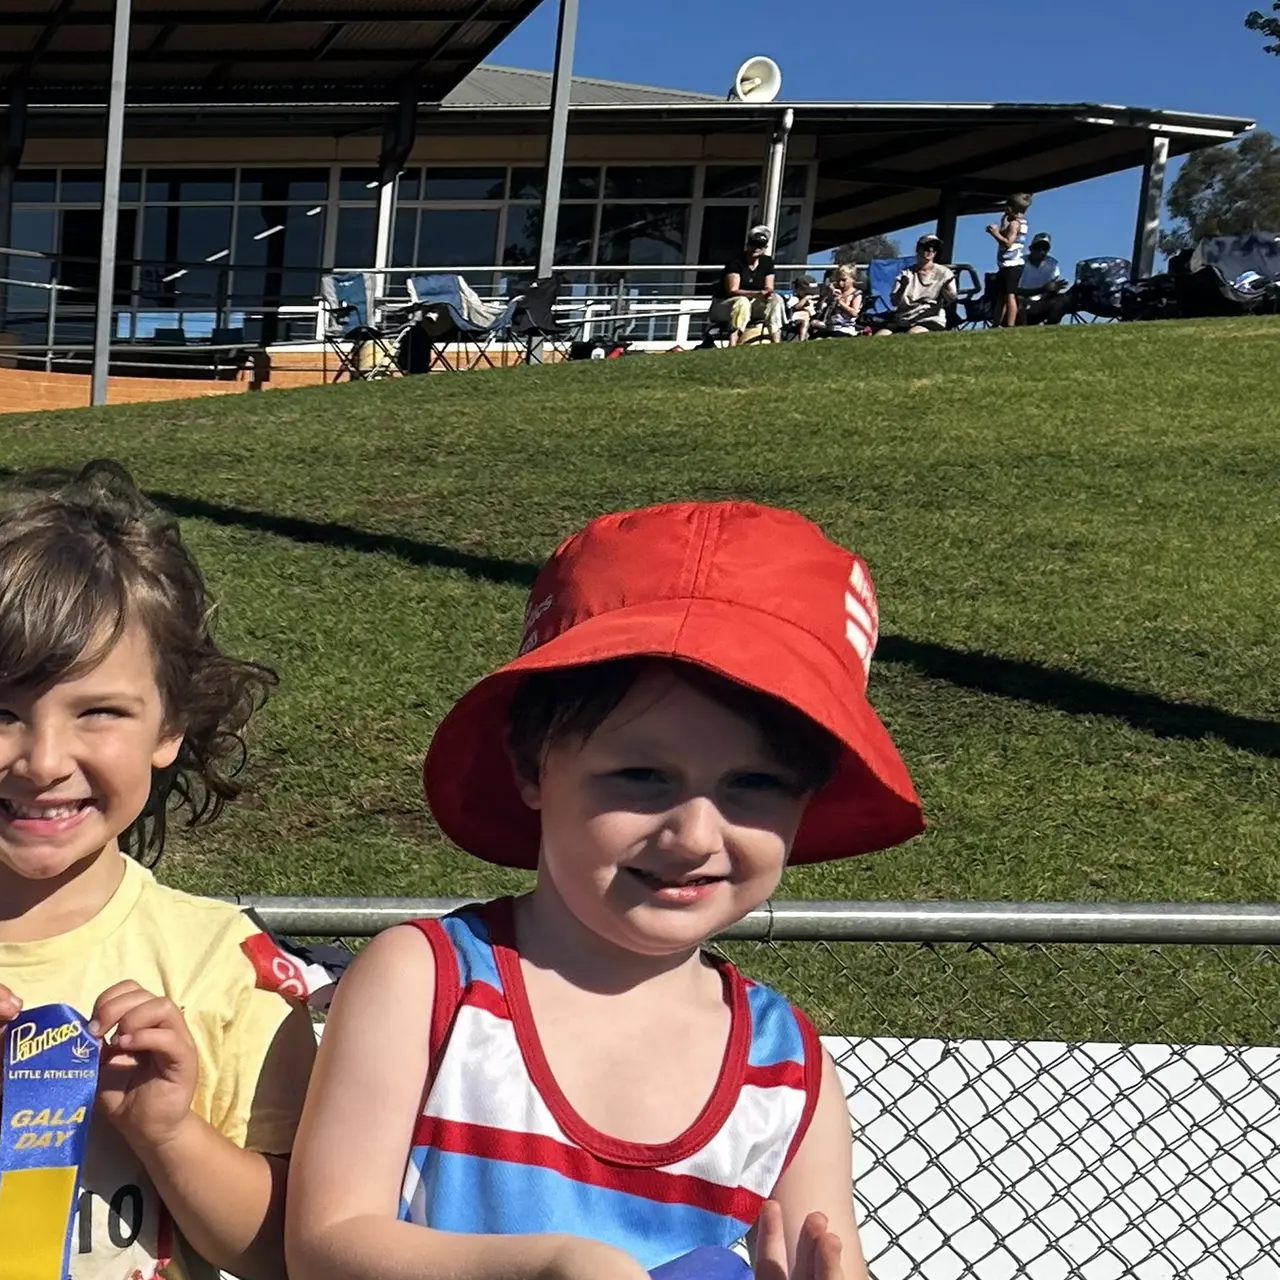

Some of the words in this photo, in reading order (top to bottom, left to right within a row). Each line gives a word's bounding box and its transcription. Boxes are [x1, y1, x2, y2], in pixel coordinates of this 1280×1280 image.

[8, 1069, 42, 1080] LITTLE
[44, 1069, 96, 1080] ATHLETICS
[11, 1106, 87, 1129] GALA
[13, 1129, 76, 1151] DAY
